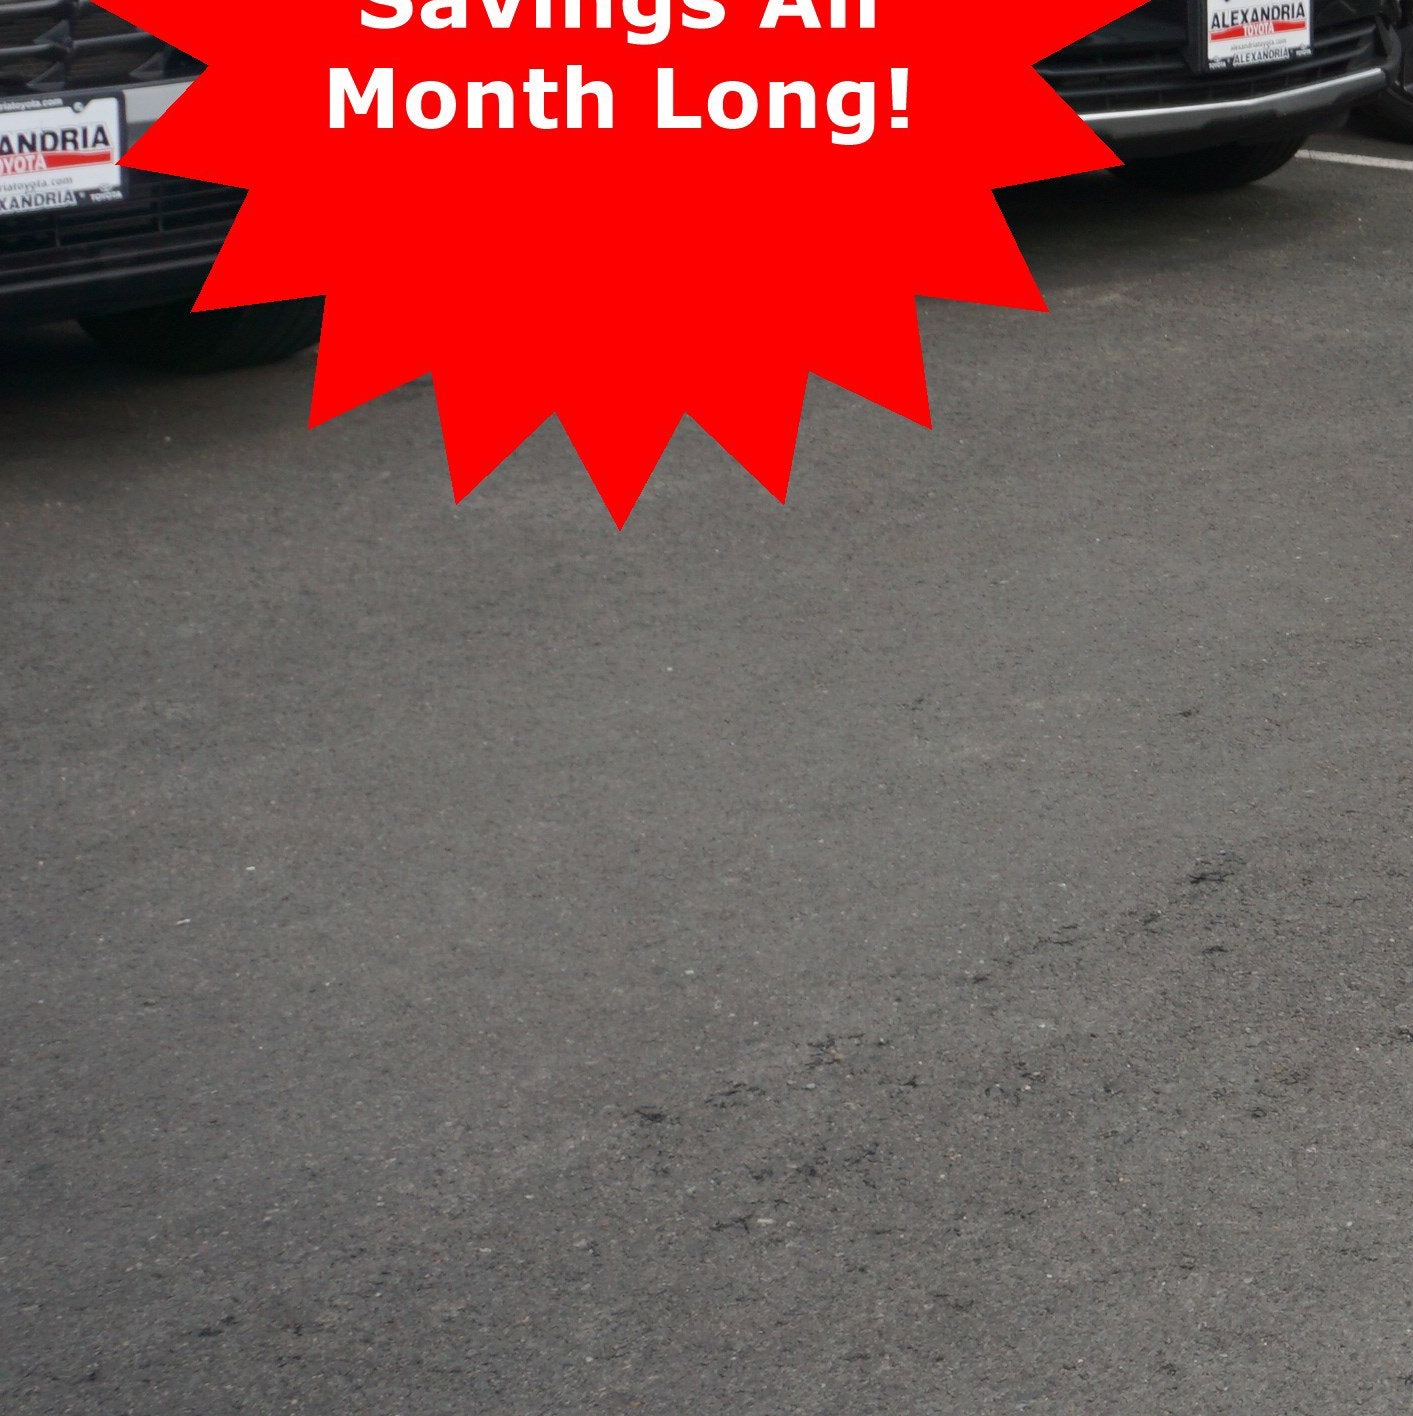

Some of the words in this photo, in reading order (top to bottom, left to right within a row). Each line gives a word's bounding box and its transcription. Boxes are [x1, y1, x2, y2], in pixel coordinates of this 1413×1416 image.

[1211, 2, 1305, 29] ALEXANDRIA
[1243, 22, 1275, 36] TOYOTA
[1233, 48, 1289, 66] ALEXANDRIA
